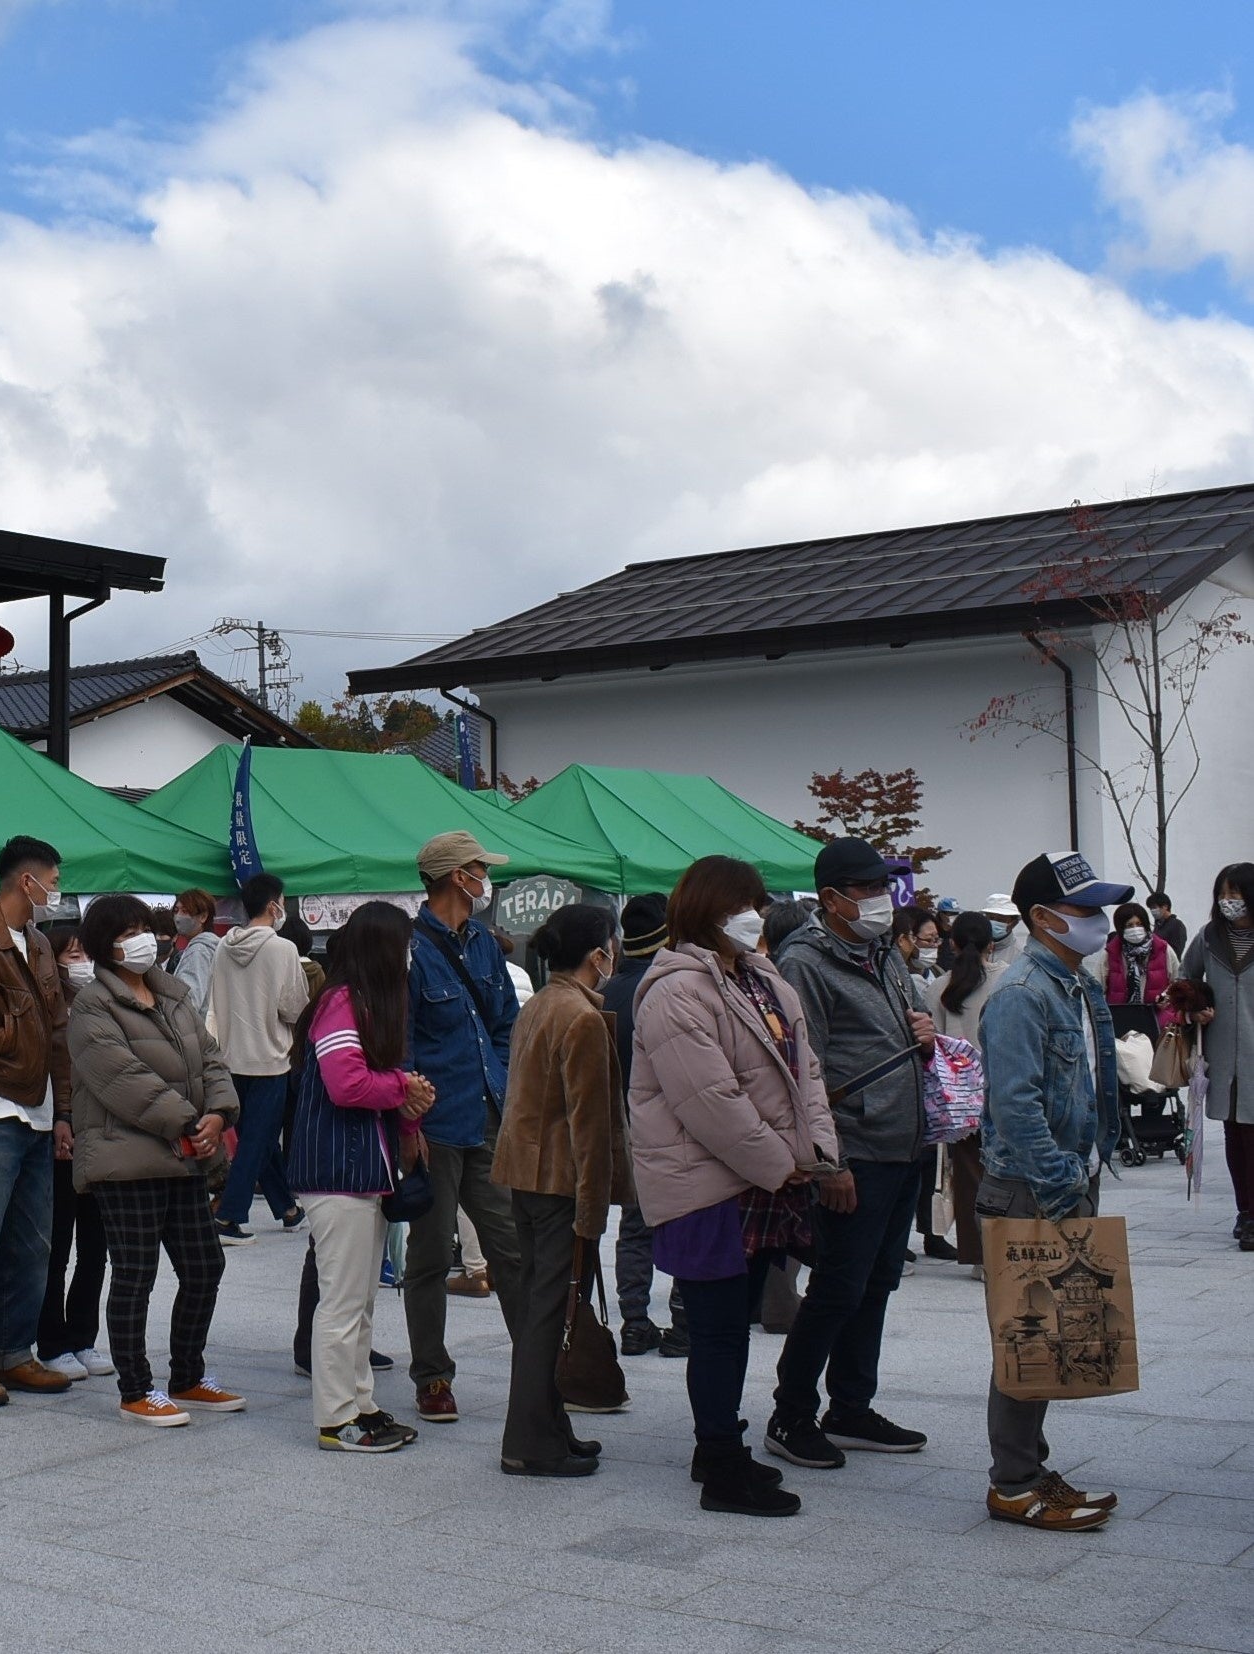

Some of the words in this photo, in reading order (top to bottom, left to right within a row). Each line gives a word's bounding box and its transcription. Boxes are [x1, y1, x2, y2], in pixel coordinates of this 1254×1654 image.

[235, 791, 252, 865] 数量限定
[1061, 865, 1081, 879] LOOKS
